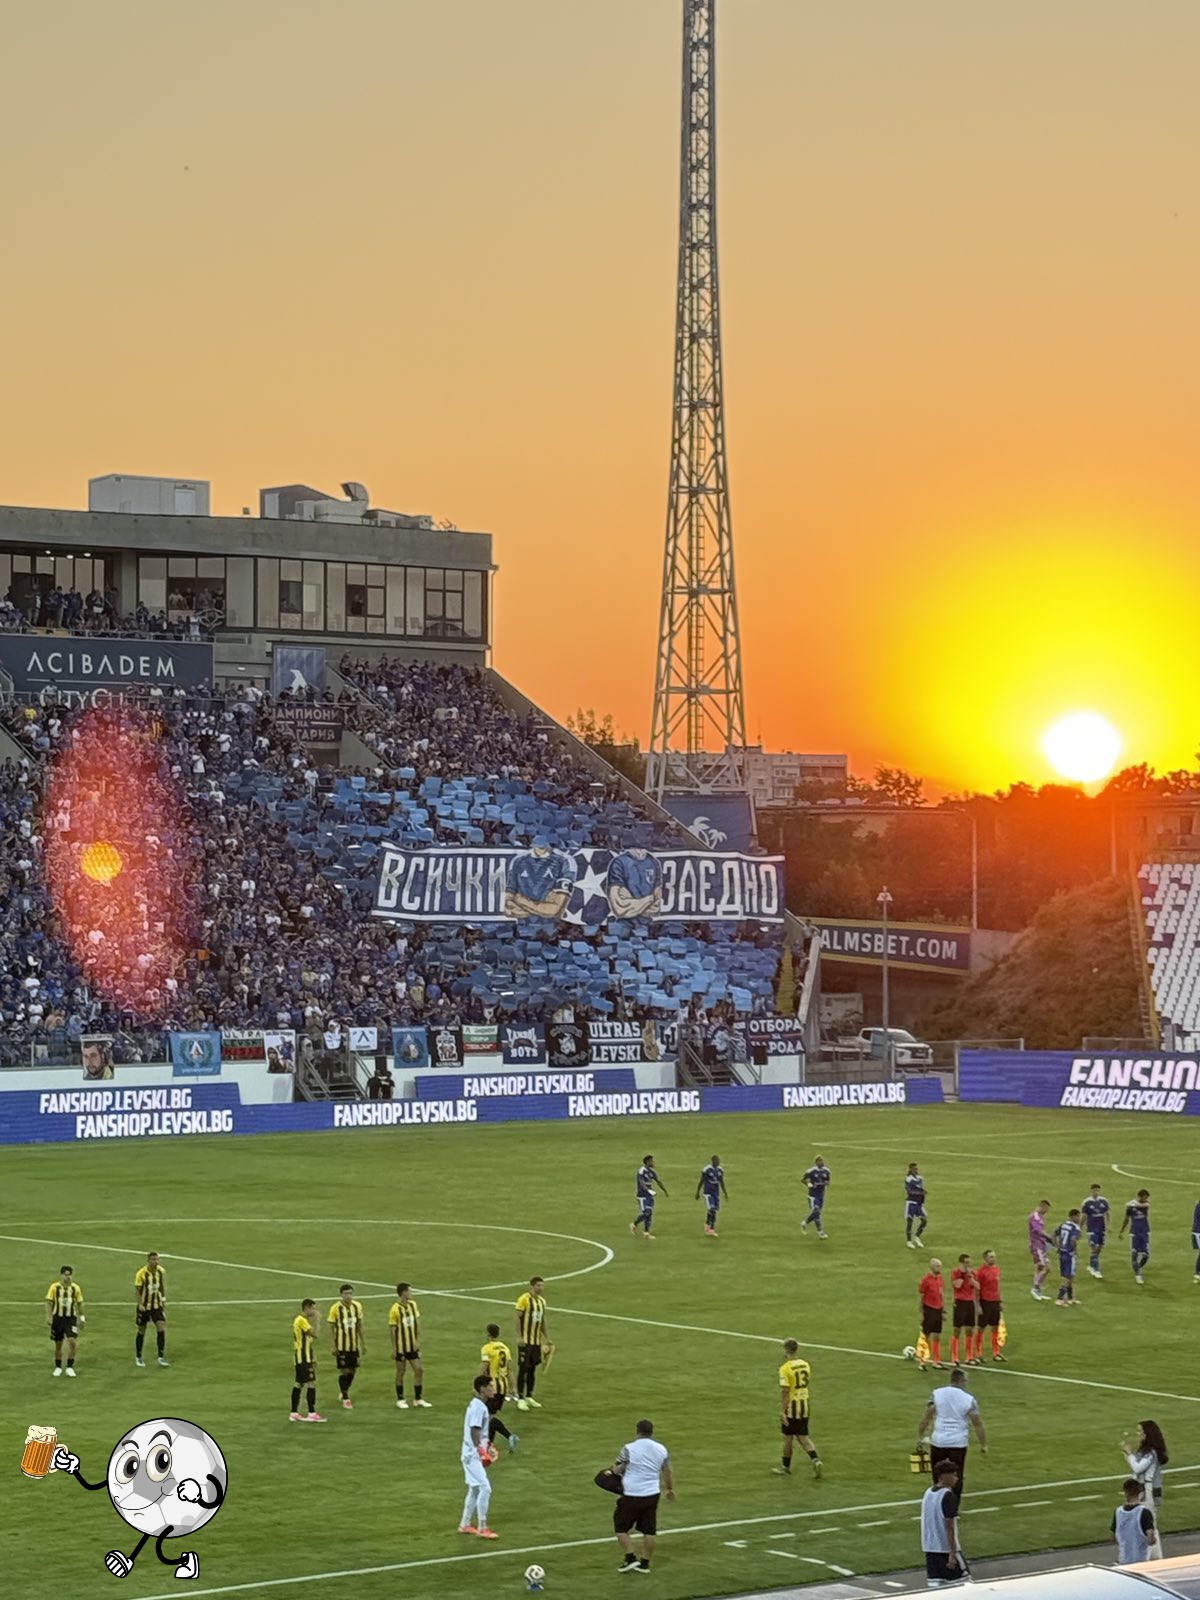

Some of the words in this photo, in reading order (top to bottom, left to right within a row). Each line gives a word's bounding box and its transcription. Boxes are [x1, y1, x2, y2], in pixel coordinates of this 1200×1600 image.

[27, 651, 175, 677] ACIBADEM
[377, 852, 507, 912] ВСИЧКИ
[660, 859, 778, 916] ЗАЕДНО
[820, 929, 957, 960] ALMSBET.COM
[224, 1030, 264, 1039] ULTRA
[589, 1021, 641, 1038] ULTRAS
[750, 1018, 802, 1033] ОТБОРА
[510, 1046, 538, 1058] BOYS
[591, 1045, 641, 1062] LEVSKI
[750, 1040, 804, 1054] РОДА
[463, 1074, 594, 1097] FANSHOP.LEVSKI.BG
[1069, 1059, 1200, 1090] FANSHO
[39, 1088, 192, 1114] FANSHOP.LEVSKI.BG
[568, 1091, 699, 1117] FANSHOP.LEVSKI.BG
[783, 1082, 906, 1107] FANSHOP.LEVSKI.BG
[1060, 1086, 1187, 1112] FANSHOP.LEVSKI.BG
[76, 1110, 233, 1138] FANSHOP.LEVSKI.BG
[334, 1100, 477, 1127] FANSHOP.LEVSKI.BG
[795, 1370, 809, 1389] 13
